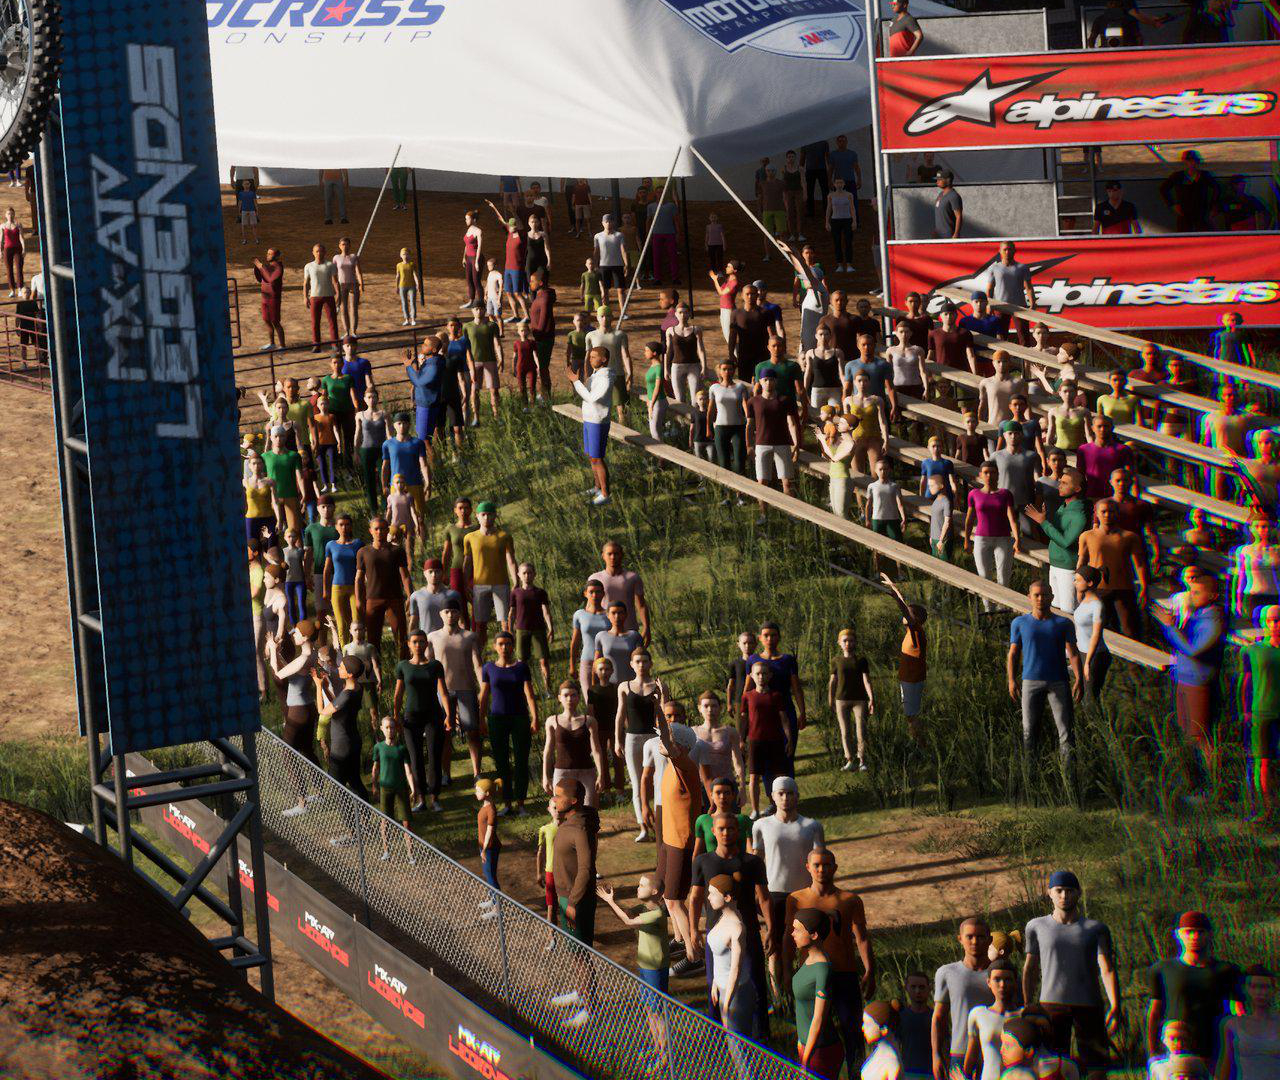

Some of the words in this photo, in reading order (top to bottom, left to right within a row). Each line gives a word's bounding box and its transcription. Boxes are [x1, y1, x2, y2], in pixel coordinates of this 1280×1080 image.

[1004, 88, 1278, 130] alpinestars
[90, 153, 139, 267] ATV
[126, 43, 203, 439] LEGENDS
[102, 282, 148, 381] MX
[367, 970, 425, 1029] LEGENDS
